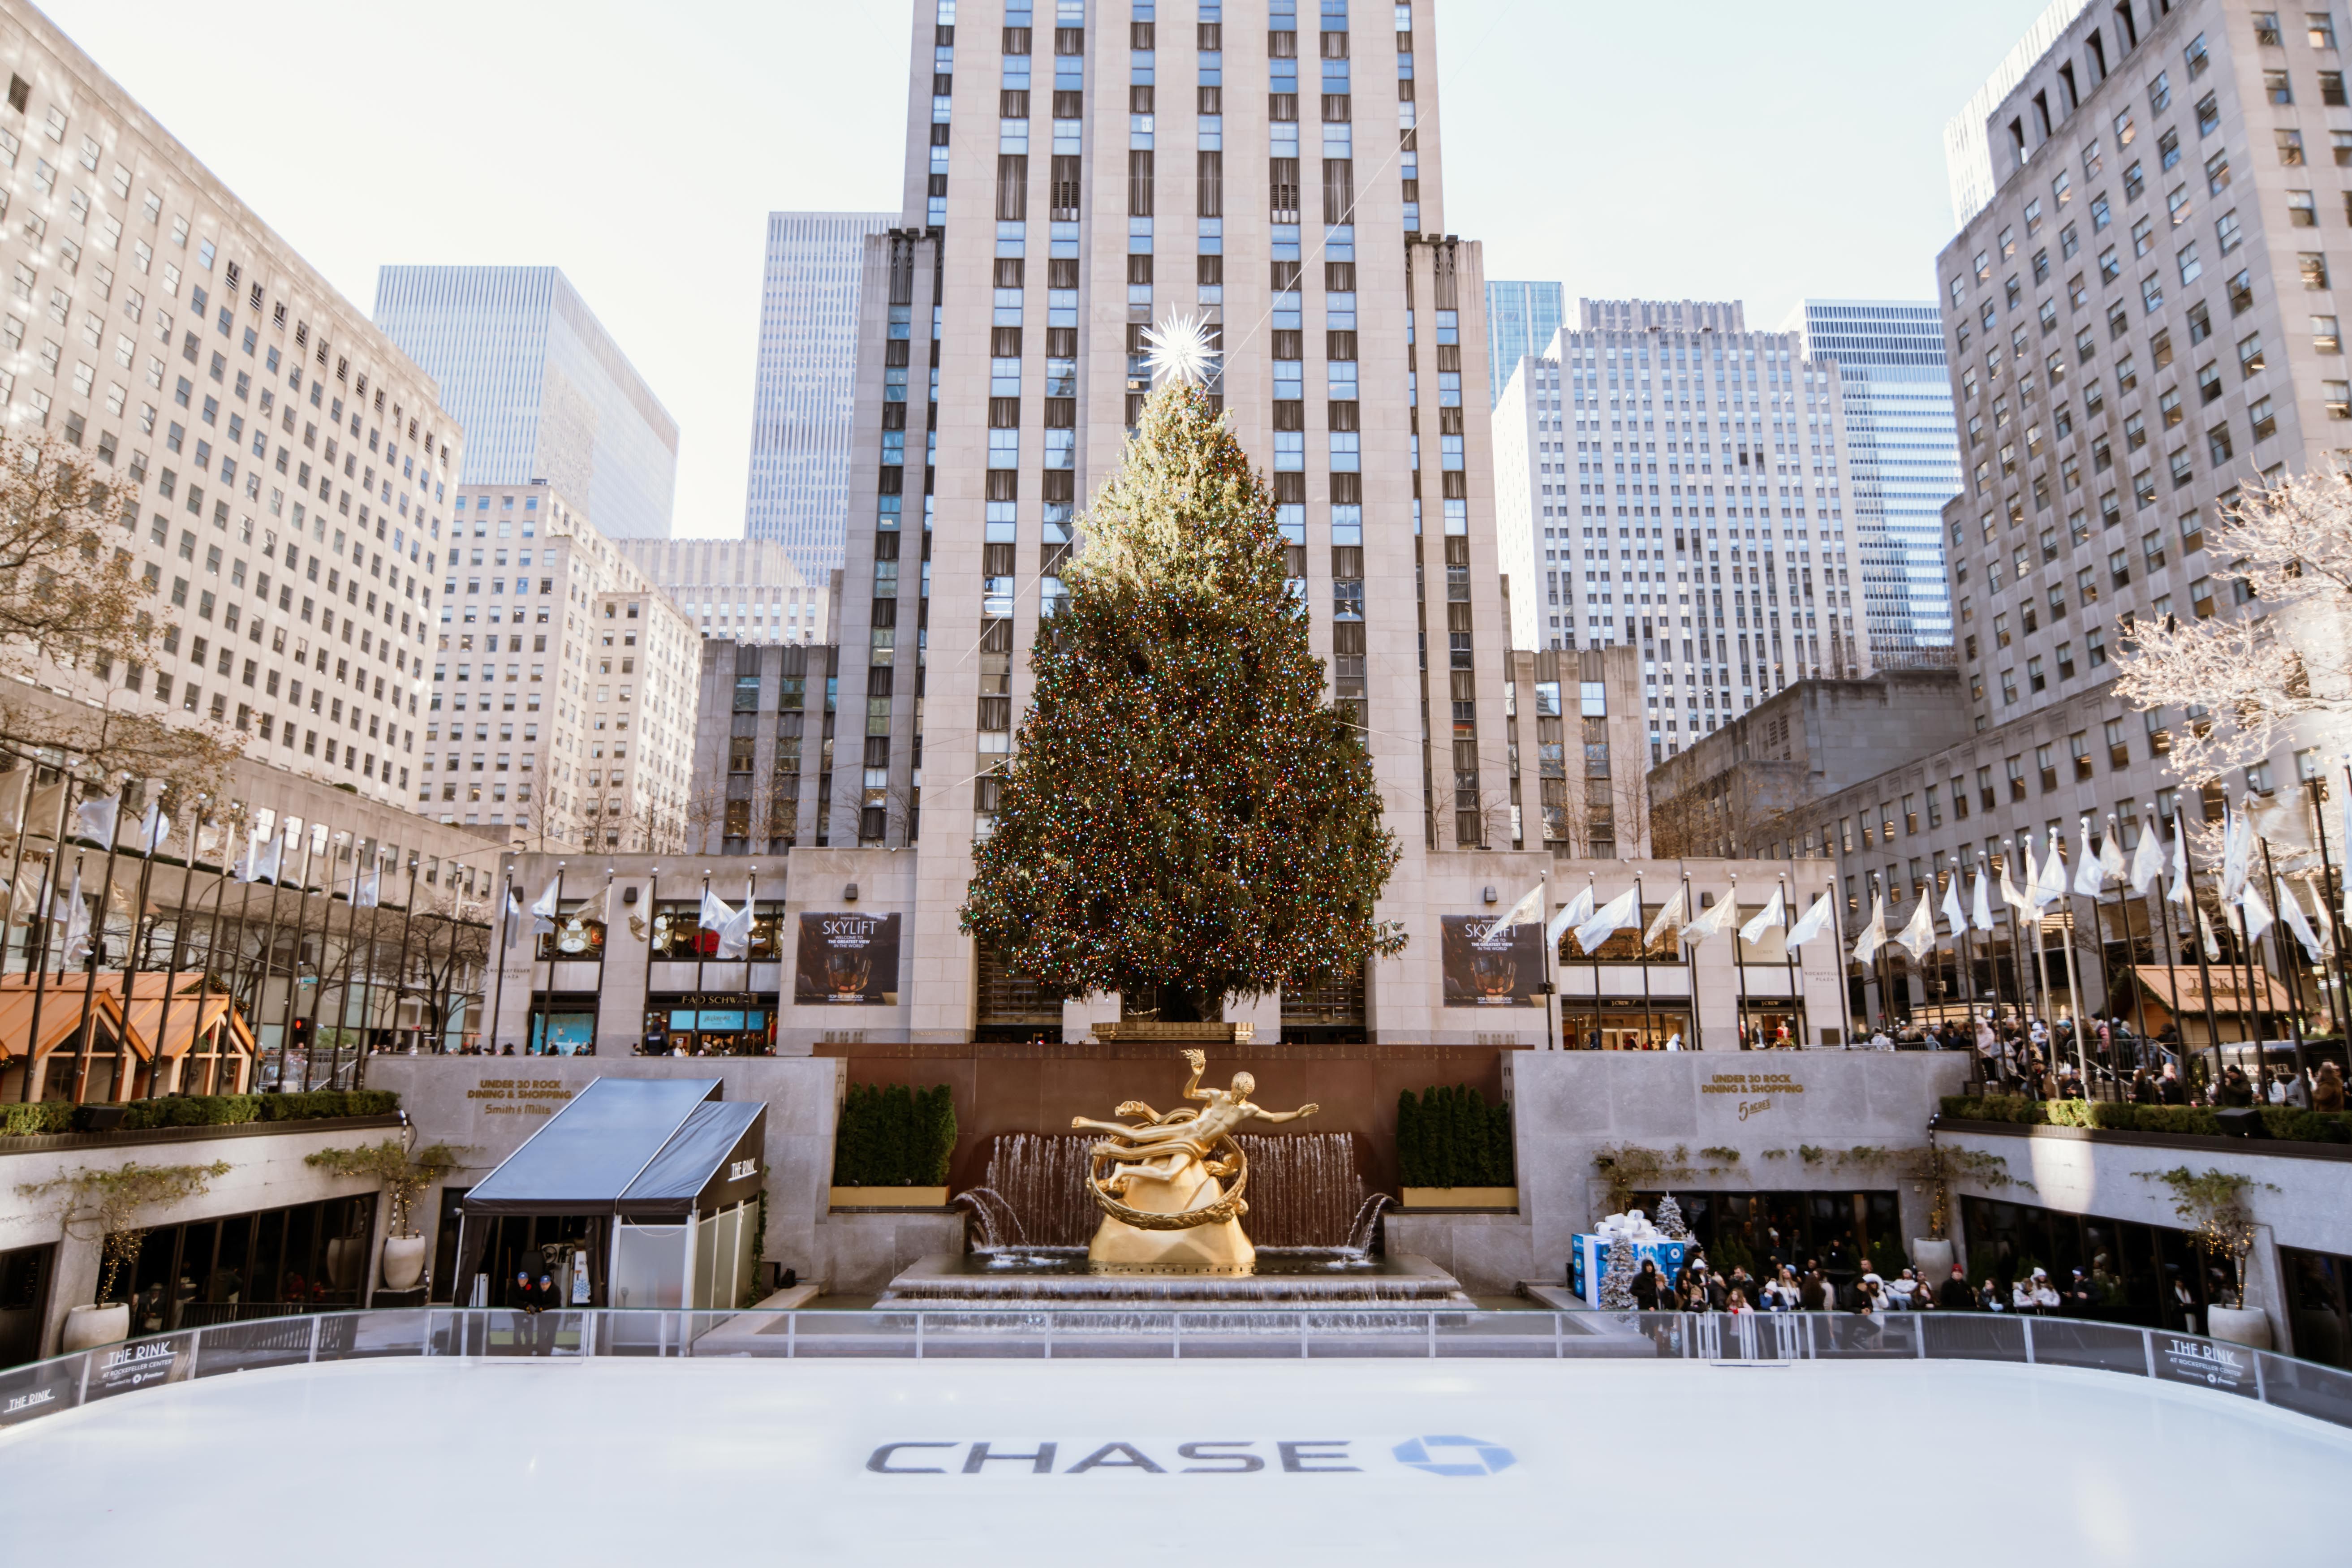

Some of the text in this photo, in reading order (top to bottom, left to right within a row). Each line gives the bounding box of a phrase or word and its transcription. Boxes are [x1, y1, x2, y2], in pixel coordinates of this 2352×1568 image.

[823, 921, 877, 934] SKYLIFT
[480, 1080, 561, 1088] UNDER 30 ROCK
[1712, 1075, 1745, 1083] UNDER
[1763, 1075, 1792, 1083] ROCK
[468, 1090, 505, 1098] DINING
[518, 1090, 572, 1099] SHOPPING
[1702, 1085, 1804, 1093] DINING & SHOPPING
[485, 1104, 515, 1114] Smith
[524, 1104, 551, 1114] Mills
[1739, 1098, 1770, 1121] 5 ACRES
[731, 1158, 756, 1178] THE RINK
[109, 1341, 171, 1366] THE RINK
[2171, 1340, 2236, 1364] THE RINK
[110, 1363, 148, 1377] ROCKEFELLER
[149, 1359, 173, 1368] CENTER
[2178, 1359, 2218, 1371] ROCKEFELLER
[2219, 1367, 2241, 1377] CENTER
[9, 1389, 52, 1410] THE RINK
[866, 1441, 1365, 1474] CHASE
